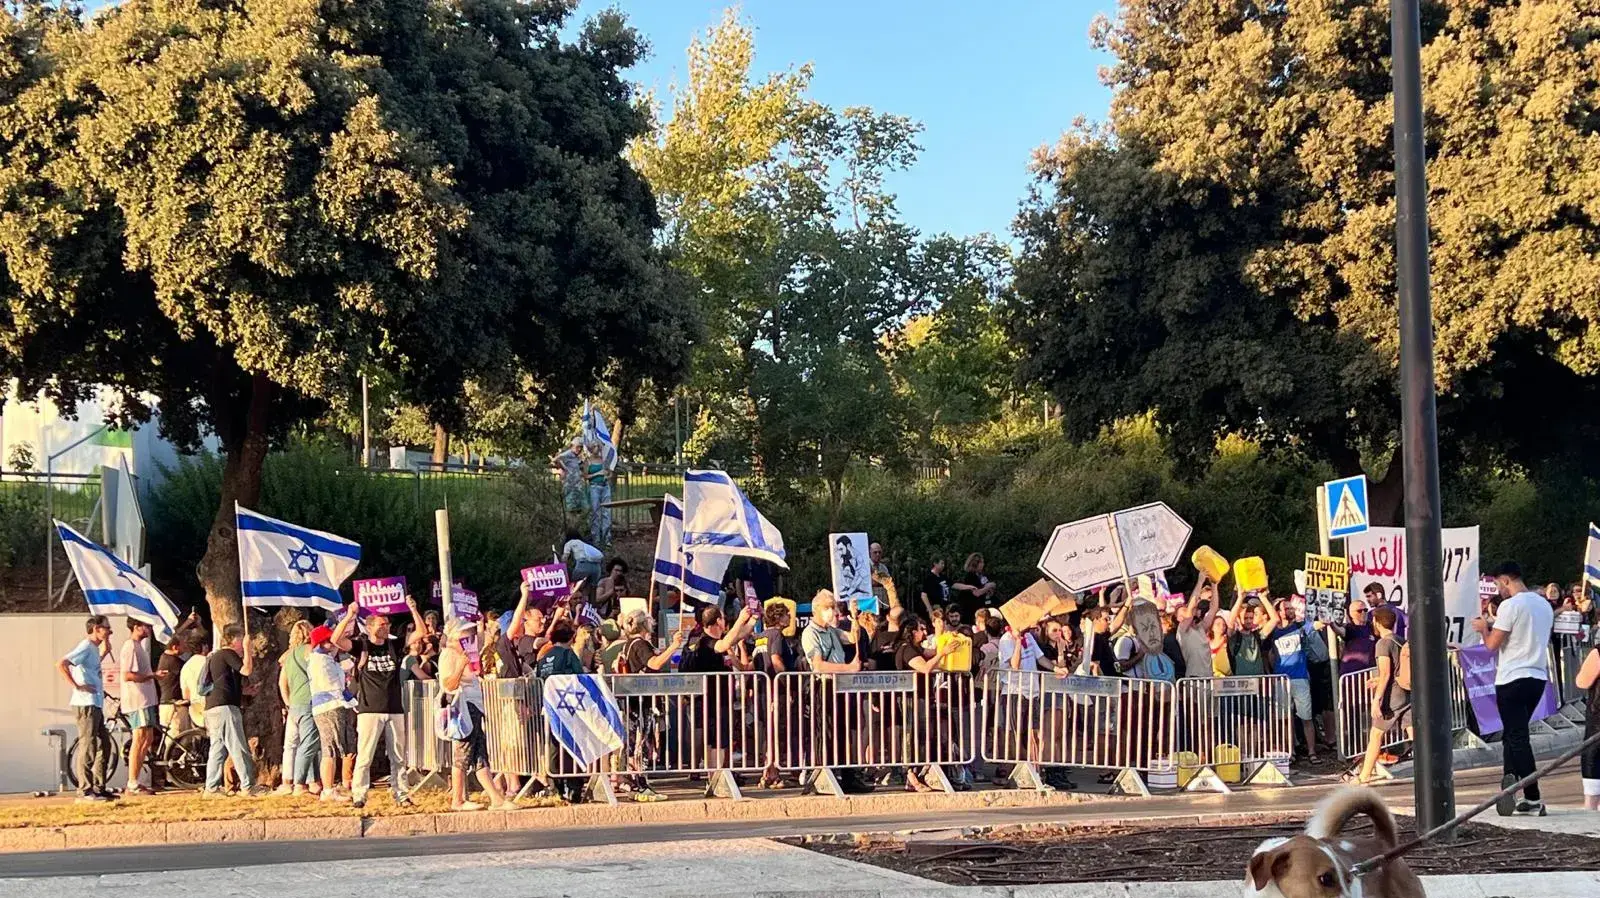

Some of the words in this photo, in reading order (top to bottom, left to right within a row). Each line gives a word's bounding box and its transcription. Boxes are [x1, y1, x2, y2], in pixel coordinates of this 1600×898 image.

[1307, 557, 1345, 573] ממשלת
[532, 577, 563, 592] שוויון
[1306, 571, 1345, 590] הביזה
[363, 591, 401, 608] שוויון
